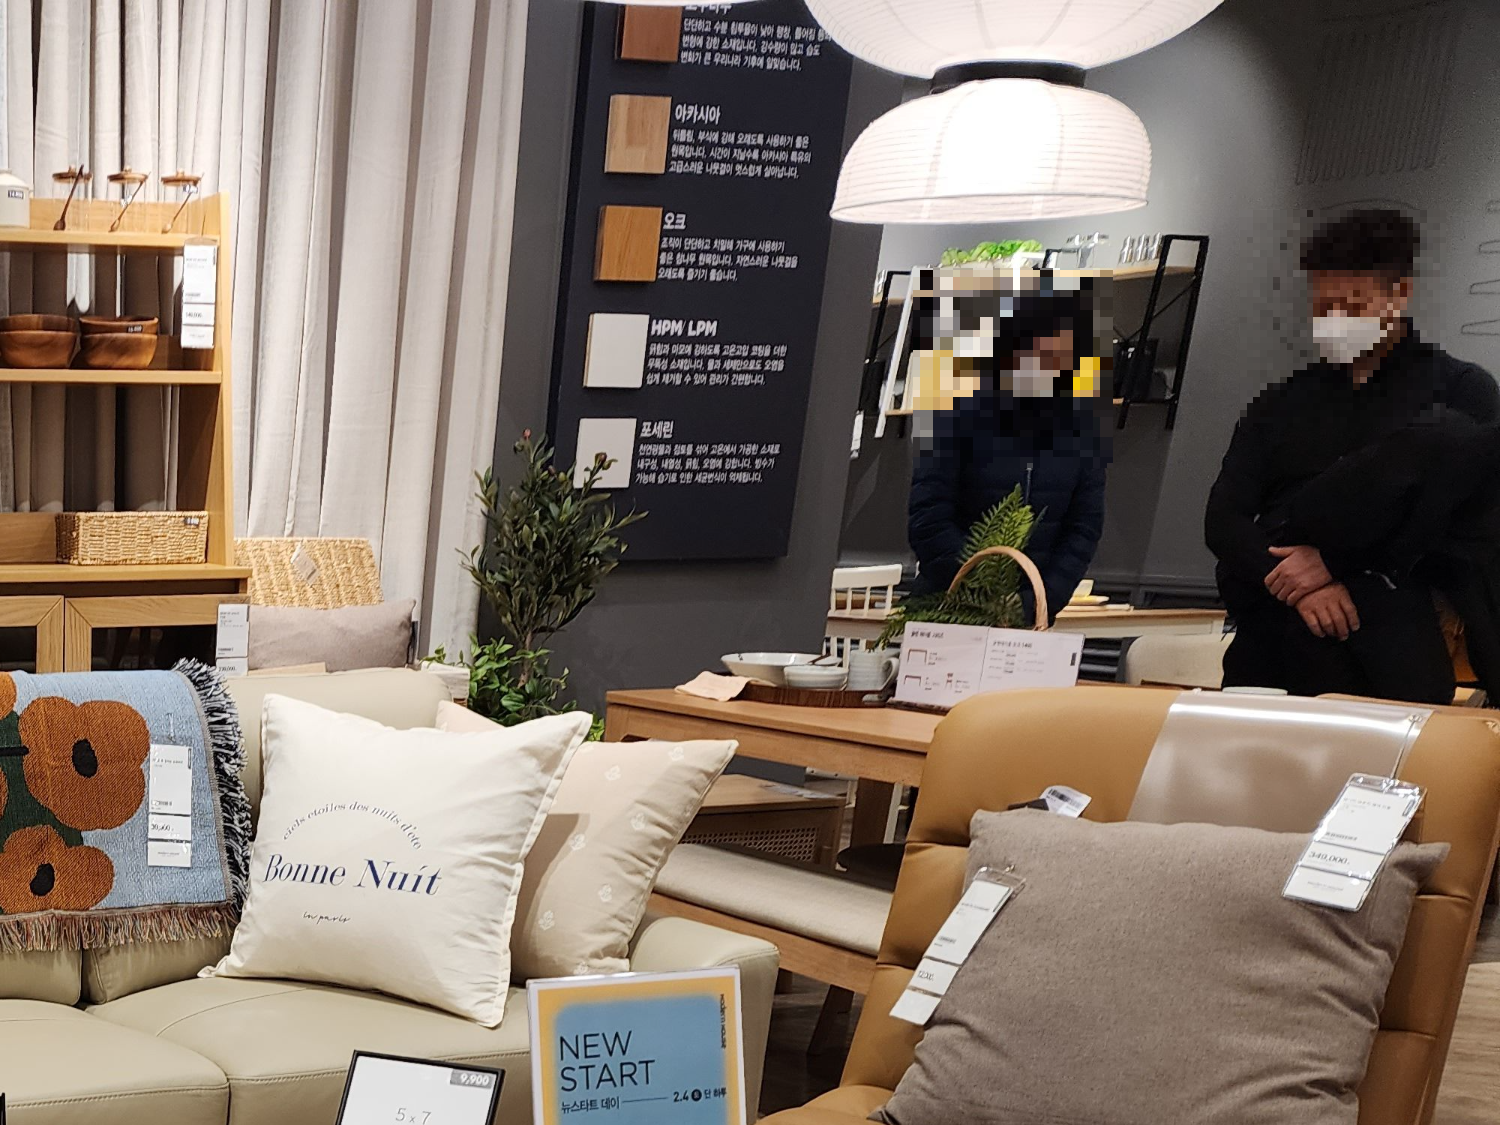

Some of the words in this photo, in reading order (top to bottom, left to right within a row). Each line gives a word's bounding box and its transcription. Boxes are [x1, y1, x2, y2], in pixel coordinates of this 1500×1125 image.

[714, 53, 740, 67] 우리나라
[675, 104, 721, 125] 아카시아
[762, 150, 788, 162] 아카시아
[663, 212, 686, 229] 오크
[688, 320, 718, 336] LPM
[684, 374, 691, 385] 수
[640, 421, 674, 438] 포세린
[350, 801, 369, 812] des
[371, 806, 401, 825] nuits
[262, 853, 346, 887] Bonne
[353, 858, 444, 896] Nuit
[559, 1030, 632, 1061] NEW
[460, 1072, 489, 1086] 9,900
[560, 1060, 656, 1093] START
[673, 1090, 688, 1103] 2.4
[704, 1089, 712, 1099] 단
[713, 1087, 727, 1098] 하루
[561, 1100, 599, 1114] 뉴스타트
[601, 1096, 620, 1110] 데이
[395, 1107, 407, 1122] 5
[409, 1115, 415, 1123] x
[421, 1111, 432, 1125] 7
